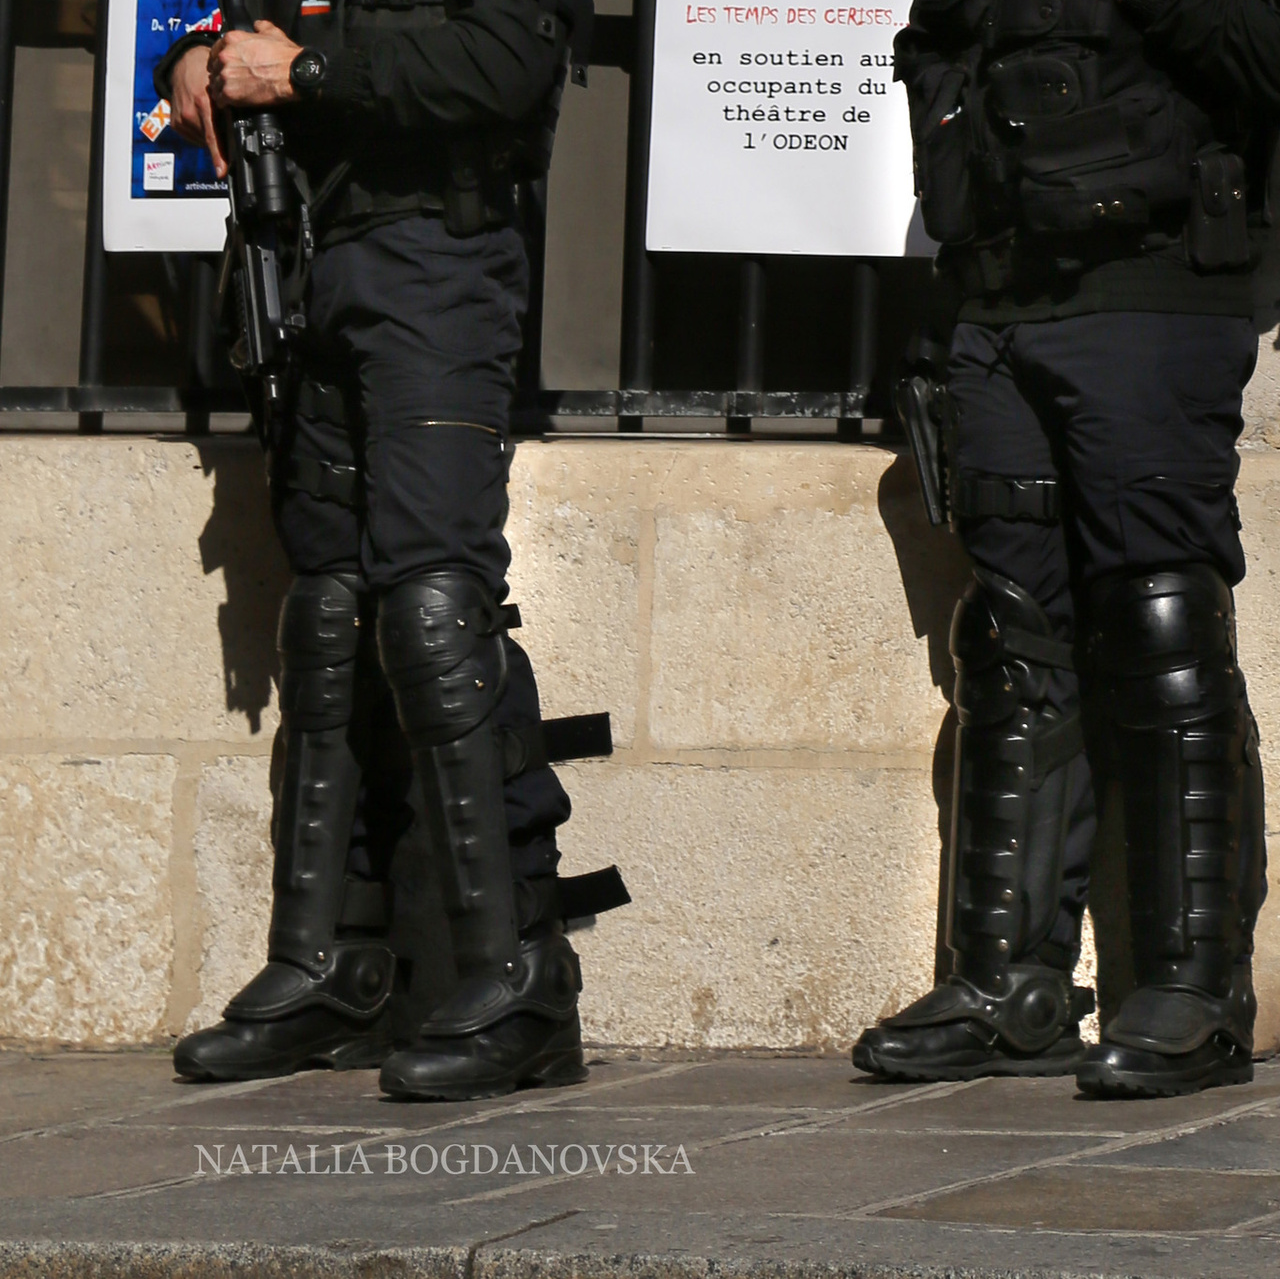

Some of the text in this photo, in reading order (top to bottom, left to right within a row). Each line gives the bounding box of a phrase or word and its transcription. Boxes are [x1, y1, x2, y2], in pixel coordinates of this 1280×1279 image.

[686, 6, 716, 24] LES
[724, 6, 778, 24] TEMPS
[788, 7, 816, 24] DES
[693, 53, 722, 64] en
[740, 50, 843, 66] soutien
[708, 79, 886, 98] occupants du
[723, 105, 870, 122] théâtre de
[744, 133, 848, 150] l'ODEON
